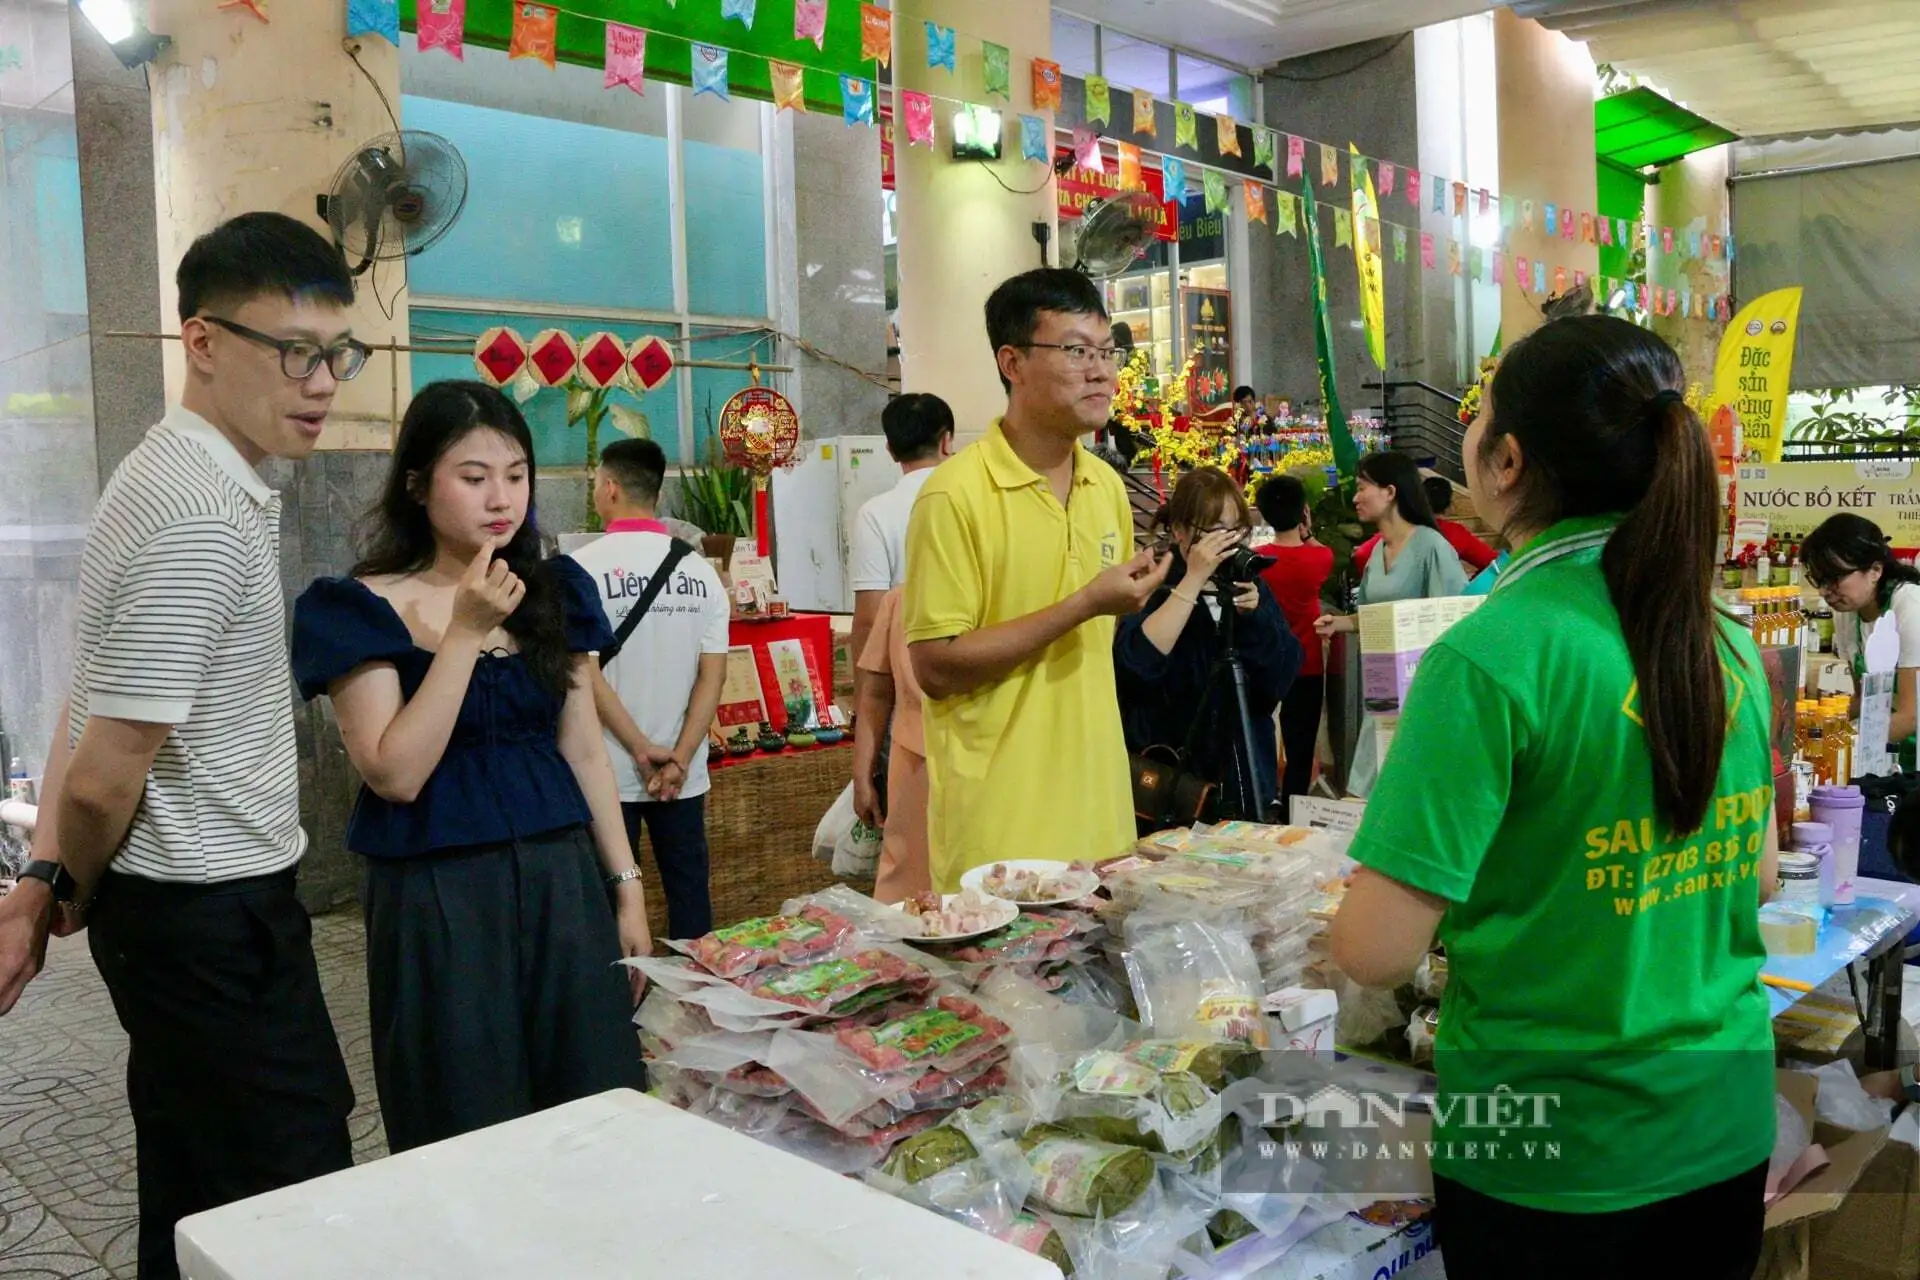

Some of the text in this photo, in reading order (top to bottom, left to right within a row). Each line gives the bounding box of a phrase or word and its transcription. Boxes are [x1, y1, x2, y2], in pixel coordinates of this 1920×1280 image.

[1740, 346, 1771, 370] Đặc
[1739, 371, 1768, 392] sản
[1743, 487, 1800, 508] NƯỚC
[1805, 485, 1832, 508] BỒ
[1837, 485, 1876, 508] KẾT
